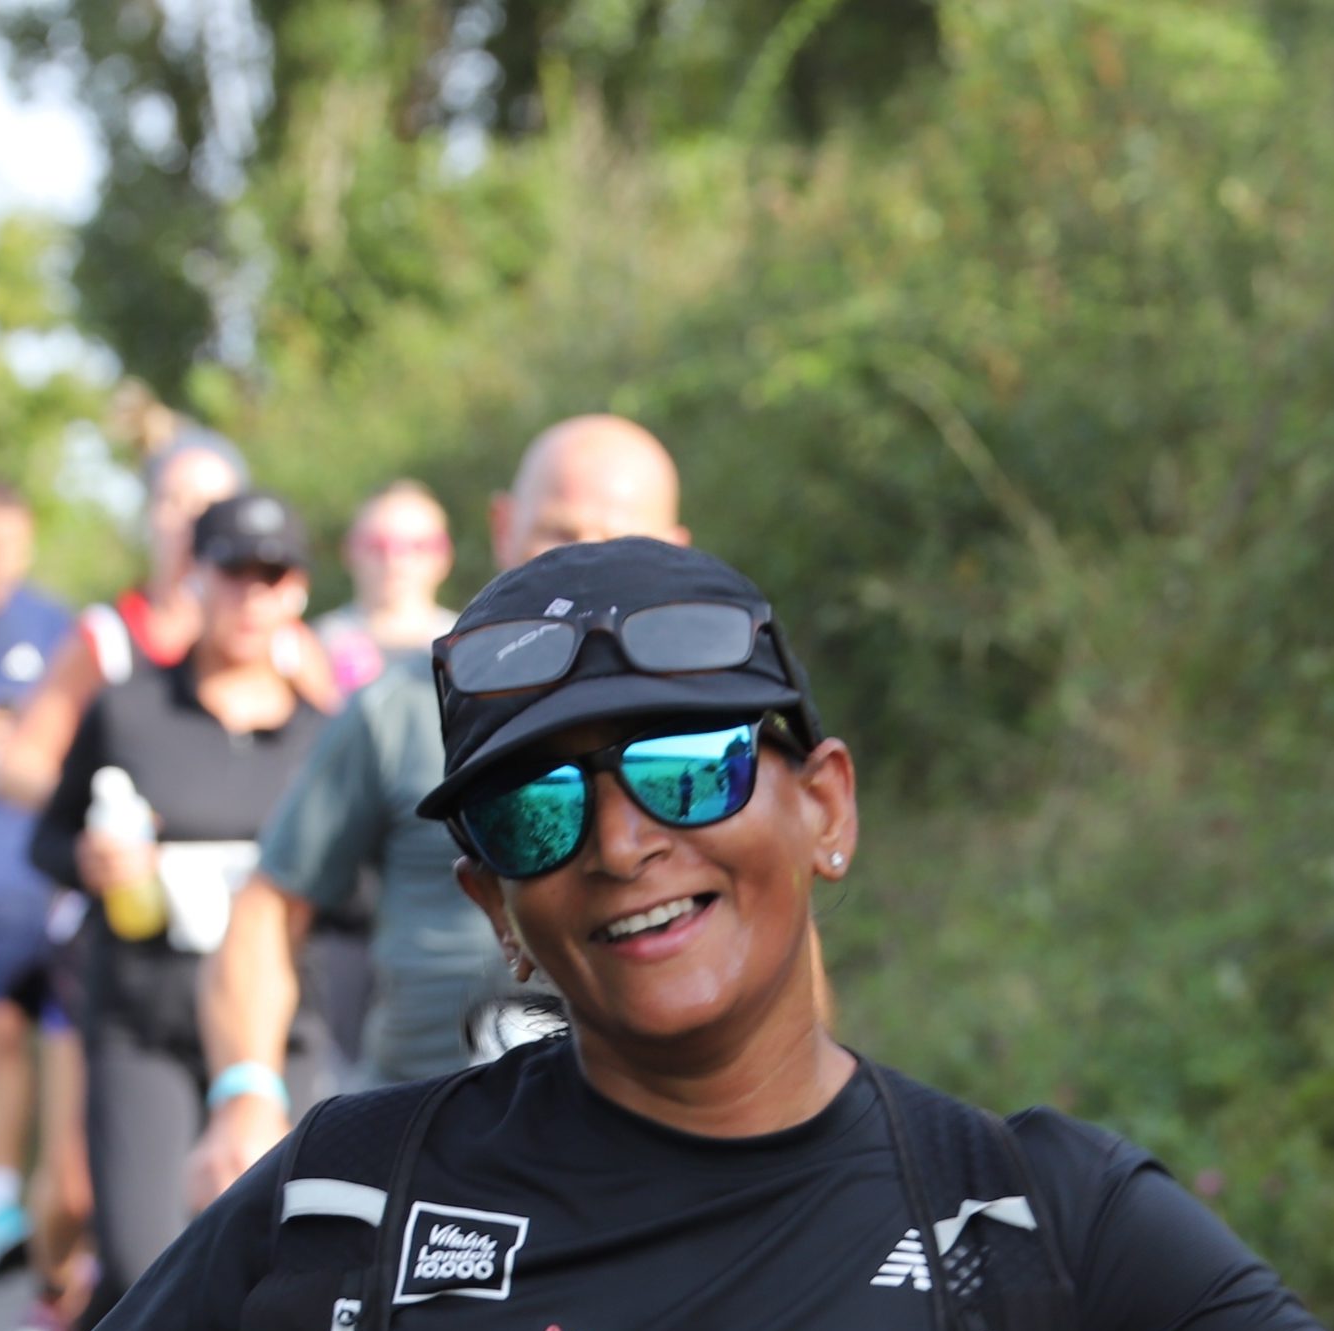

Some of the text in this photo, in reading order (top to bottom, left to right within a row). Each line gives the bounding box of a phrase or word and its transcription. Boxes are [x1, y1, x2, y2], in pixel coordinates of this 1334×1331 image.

[429, 1223, 498, 1253] Vitality
[418, 1245, 496, 1263] London
[413, 1259, 494, 1280] 10,000
